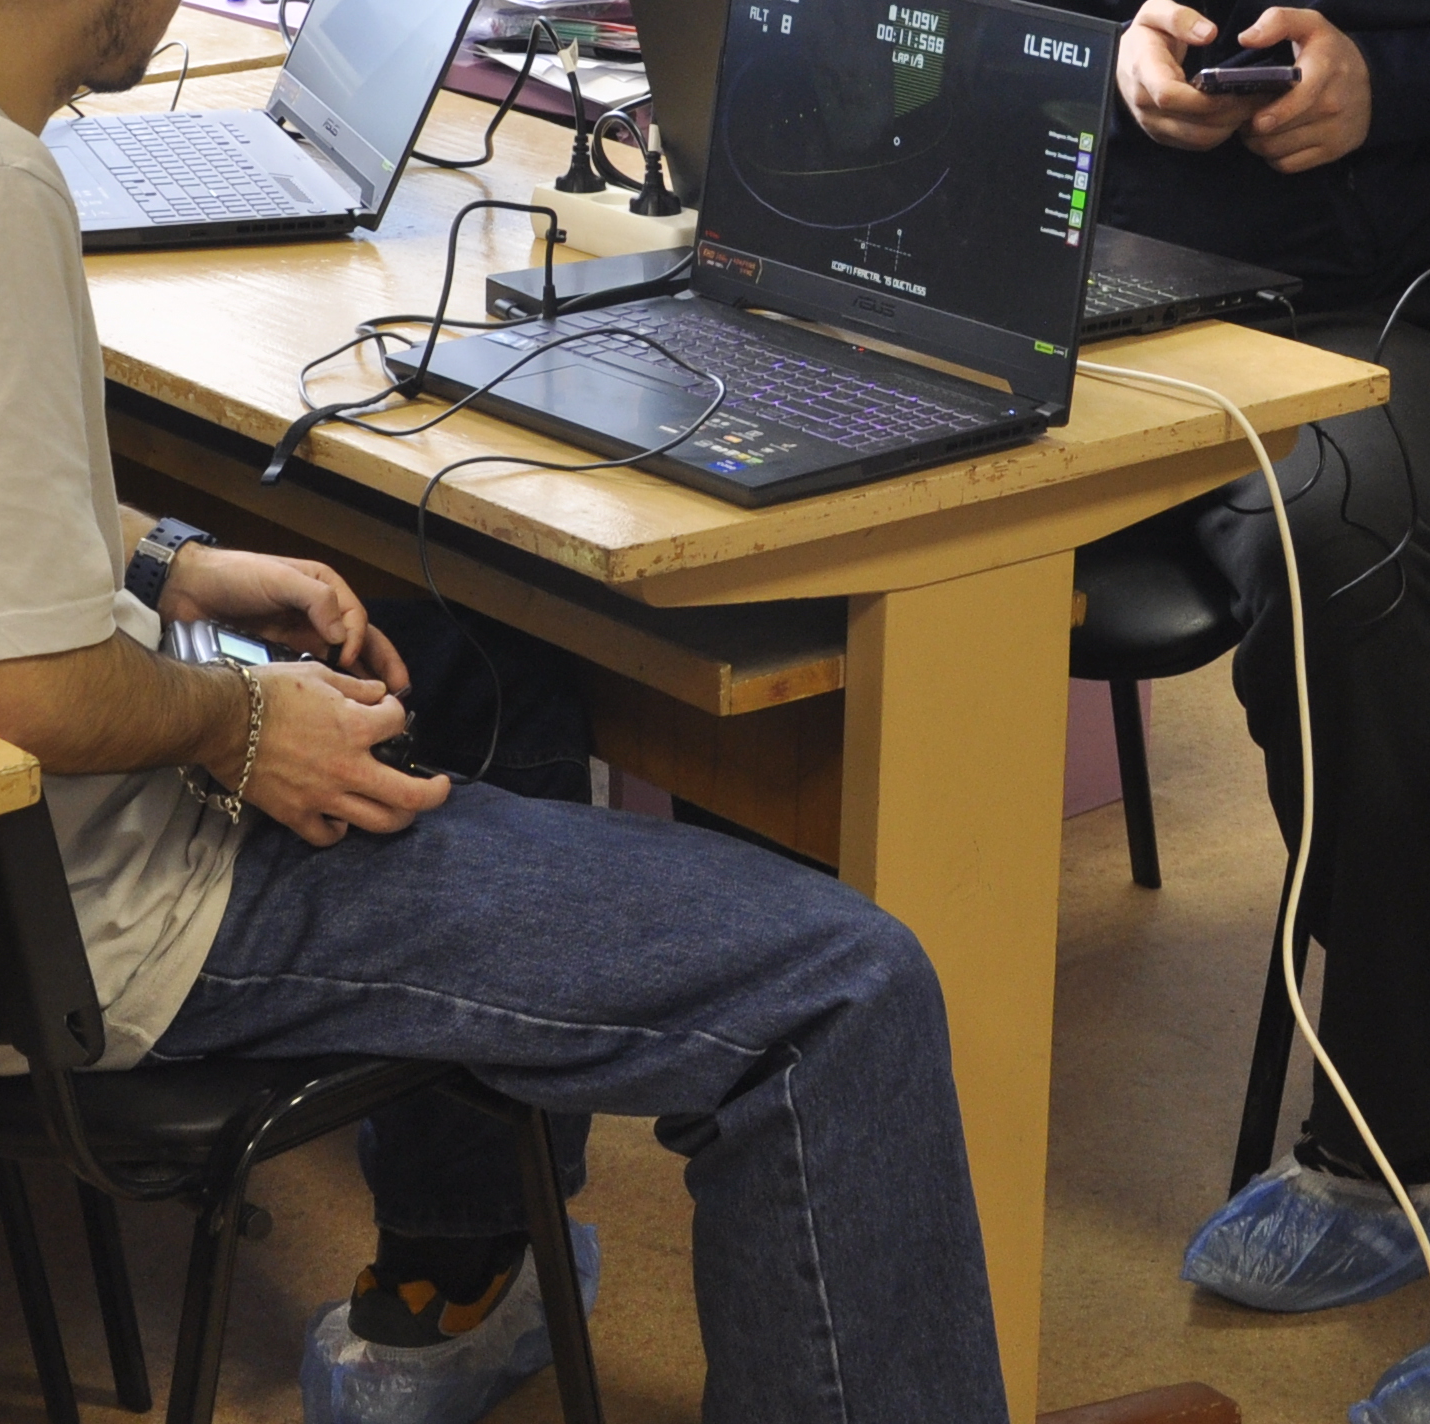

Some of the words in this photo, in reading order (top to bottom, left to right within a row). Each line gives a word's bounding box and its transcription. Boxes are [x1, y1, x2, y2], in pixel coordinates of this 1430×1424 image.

[749, 5, 770, 22] ALT
[780, 13, 793, 35] 8
[900, 7, 939, 32] 4.09V
[892, 50, 910, 64] LAP
[852, 295, 896, 318] ASUS
